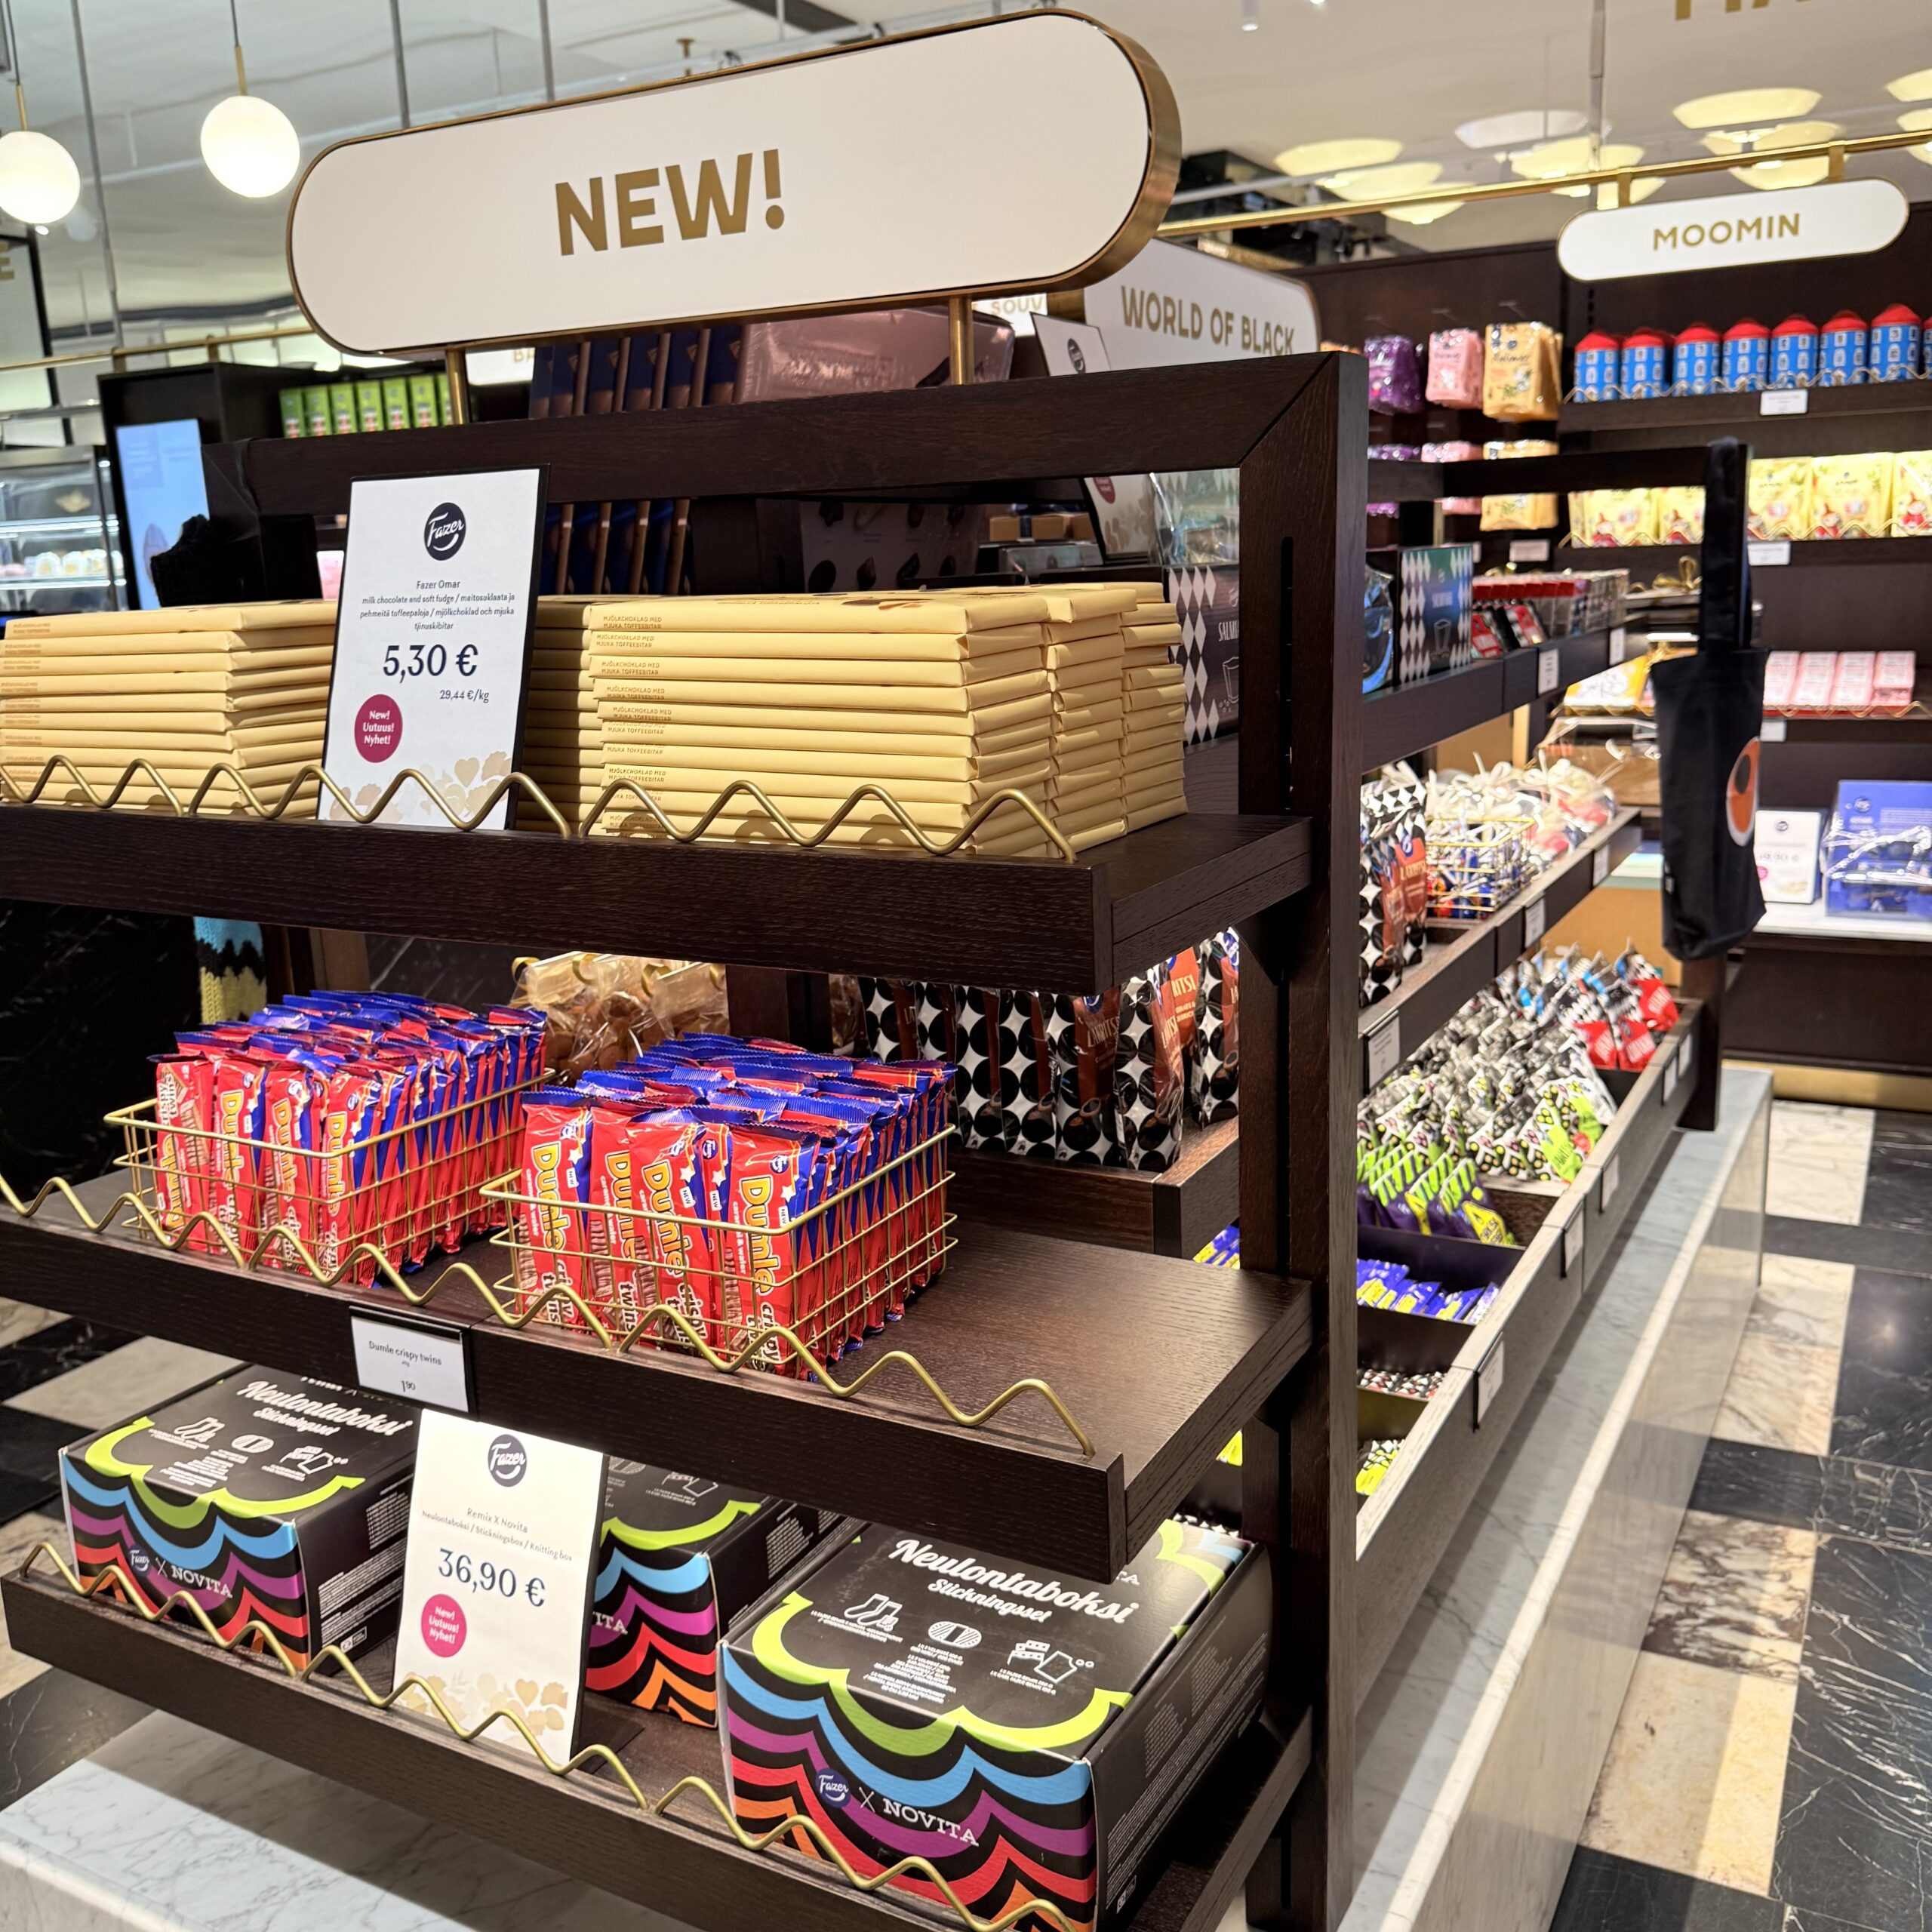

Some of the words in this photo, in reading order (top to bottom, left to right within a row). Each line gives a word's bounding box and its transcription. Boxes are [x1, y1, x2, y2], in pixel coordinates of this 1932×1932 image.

[555, 149, 785, 257] NEW!
[1653, 212, 1801, 251] MOOMIN
[991, 297, 1043, 315] SOUV
[1121, 285, 1203, 340] WORLD
[1211, 308, 1234, 346] OF
[1241, 317, 1295, 356] BLACK
[426, 512, 464, 547] Fazer
[417, 580, 436, 589] Fazer
[438, 580, 460, 589] Omar
[362, 595, 376, 605] milk
[377, 595, 408, 605] chocolate
[409, 595, 421, 603] and
[422, 594, 435, 603] soft
[435, 594, 454, 605] fudge
[455, 593, 460, 603] /
[460, 593, 507, 602] maitosuklaata
[509, 593, 515, 602] ja
[360, 609, 390, 620] pehmeitä
[391, 609, 429, 619] toffeepaloja
[429, 608, 435, 617] /
[435, 607, 479, 617] mjölkchoklad
[480, 607, 492, 615] och
[494, 607, 514, 617] mjuka
[1218, 620, 1239, 641] SALMI
[383, 644, 447, 683] 5,30
[456, 644, 478, 676] €
[439, 689, 465, 700] 29,44
[466, 688, 489, 703] €/kg
[363, 722, 394, 733] Uutuus!
[369, 710, 390, 720] New!
[364, 734, 391, 746] Nyhet!
[642, 1158, 692, 1277] Dumle
[740, 1175, 780, 1296] Dumle
[369, 1341, 394, 1355] Dumle
[395, 1348, 418, 1363] crispy
[420, 1353, 442, 1366] twins
[237, 1380, 414, 1436] Neulontaboksi
[490, 1441, 526, 1471] Fazer
[467, 1507, 492, 1522] Remix
[494, 1515, 499, 1524] X
[501, 1518, 528, 1534] Novita
[422, 1509, 469, 1531] Neulontaboksi
[475, 1525, 523, 1547] Stickningsbox
[530, 1540, 558, 1560] Knitting
[559, 1550, 572, 1561] box
[171, 1565, 232, 1599] NOVITA
[438, 1547, 517, 1598] 36,90
[525, 1577, 546, 1607] €
[888, 1539, 1140, 1623] Neulontaboksi
[429, 1614, 459, 1634] Uutuus!
[435, 1606, 455, 1620] New!
[592, 1611, 628, 1635] ITA
[429, 1627, 455, 1644] Nyhet!
[819, 1774, 849, 1794] Fazer
[882, 1797, 980, 1847] NOVITA
